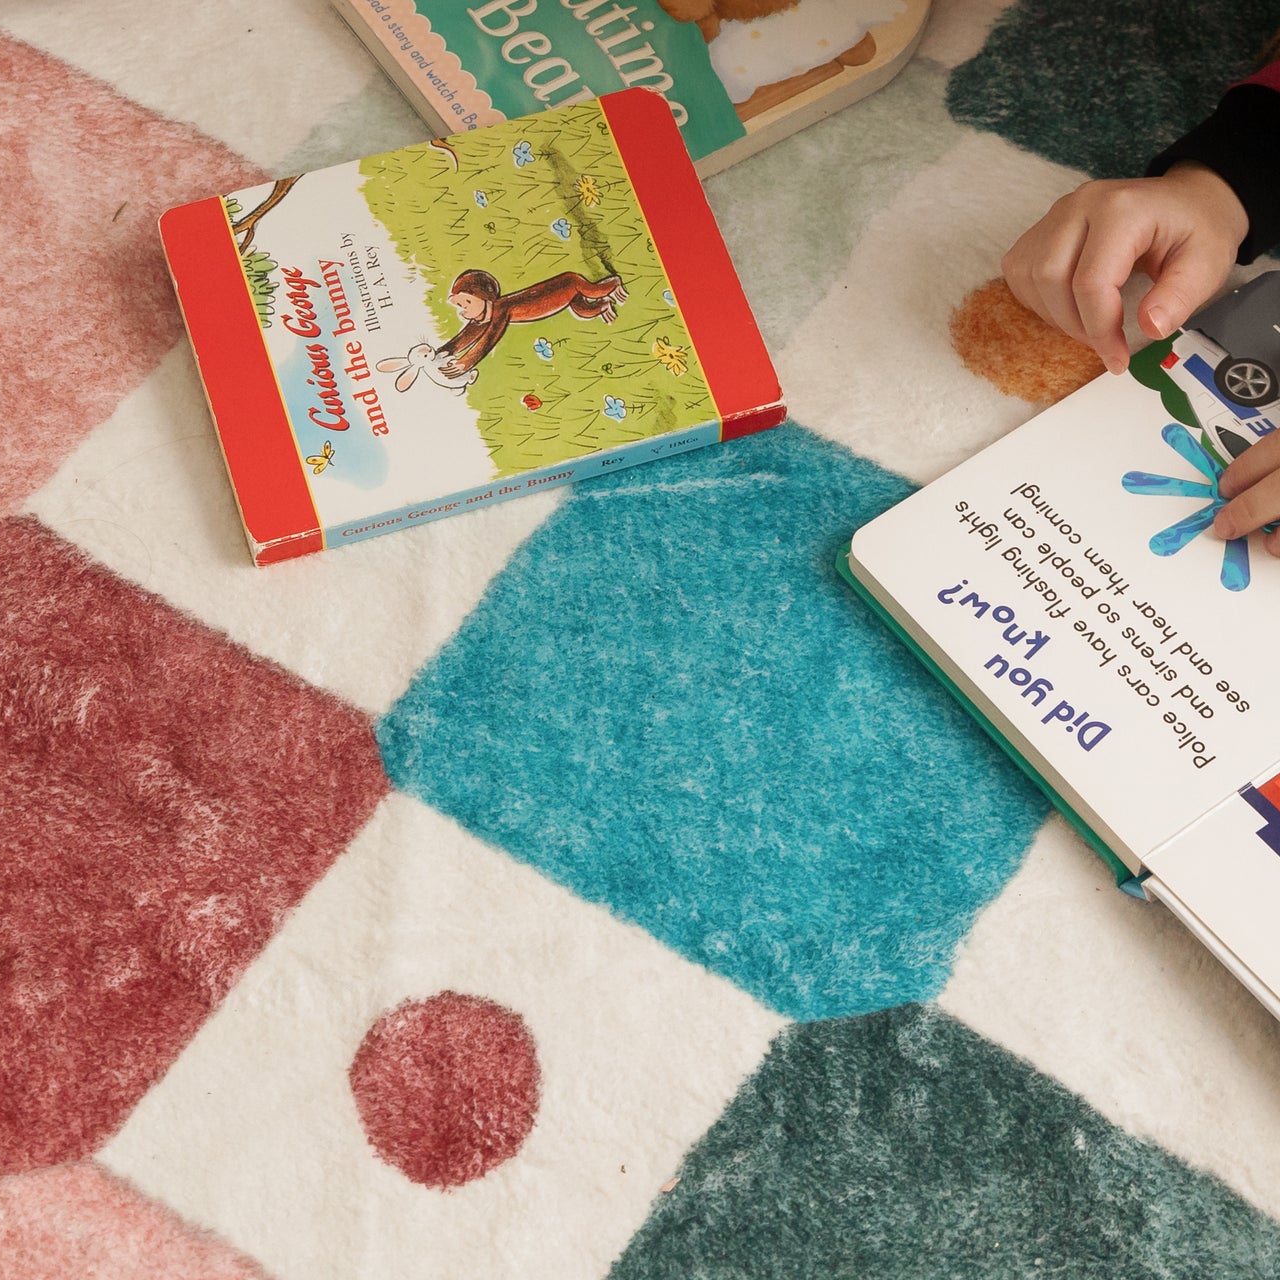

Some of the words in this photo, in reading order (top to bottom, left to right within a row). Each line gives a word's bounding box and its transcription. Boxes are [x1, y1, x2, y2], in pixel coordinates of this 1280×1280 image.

[381, 14, 391, 22] a
[388, 22, 414, 51] story
[410, 50, 434, 69] and
[426, 70, 458, 102] watch
[451, 102, 466, 116] as
[339, 232, 356, 249] by
[364, 245, 381, 270] Rey
[280, 266, 322, 339] George
[318, 259, 357, 338] bunny
[347, 250, 381, 332] Illustrations
[372, 272, 388, 288] A.
[377, 290, 394, 309] H.
[344, 340, 371, 382] the
[306, 343, 350, 431] Curious
[352, 387, 390, 437] and
[601, 456, 626, 467] Rey
[342, 516, 403, 537] Curious
[407, 501, 461, 519] George
[465, 490, 494, 505] and
[498, 483, 522, 496] the
[527, 470, 576, 488] Bunny
[955, 501, 1003, 551] lights
[1003, 507, 1036, 538] can
[1010, 482, 1082, 544] coming!
[1001, 546, 1071, 619] flashing
[1037, 543, 1101, 599] people
[1084, 547, 1130, 596] them
[937, 579, 1051, 660] know?
[1097, 603, 1121, 623] so
[1132, 600, 1178, 644] hear
[1073, 620, 1117, 668] have
[1121, 627, 1178, 682] sirens
[1170, 642, 1213, 676] and
[984, 654, 1054, 707] you
[1117, 665, 1160, 707] cars
[1170, 684, 1214, 719] and
[1215, 680, 1250, 713] see
[1040, 700, 1113, 752] Did
[1163, 712, 1217, 769] Police
